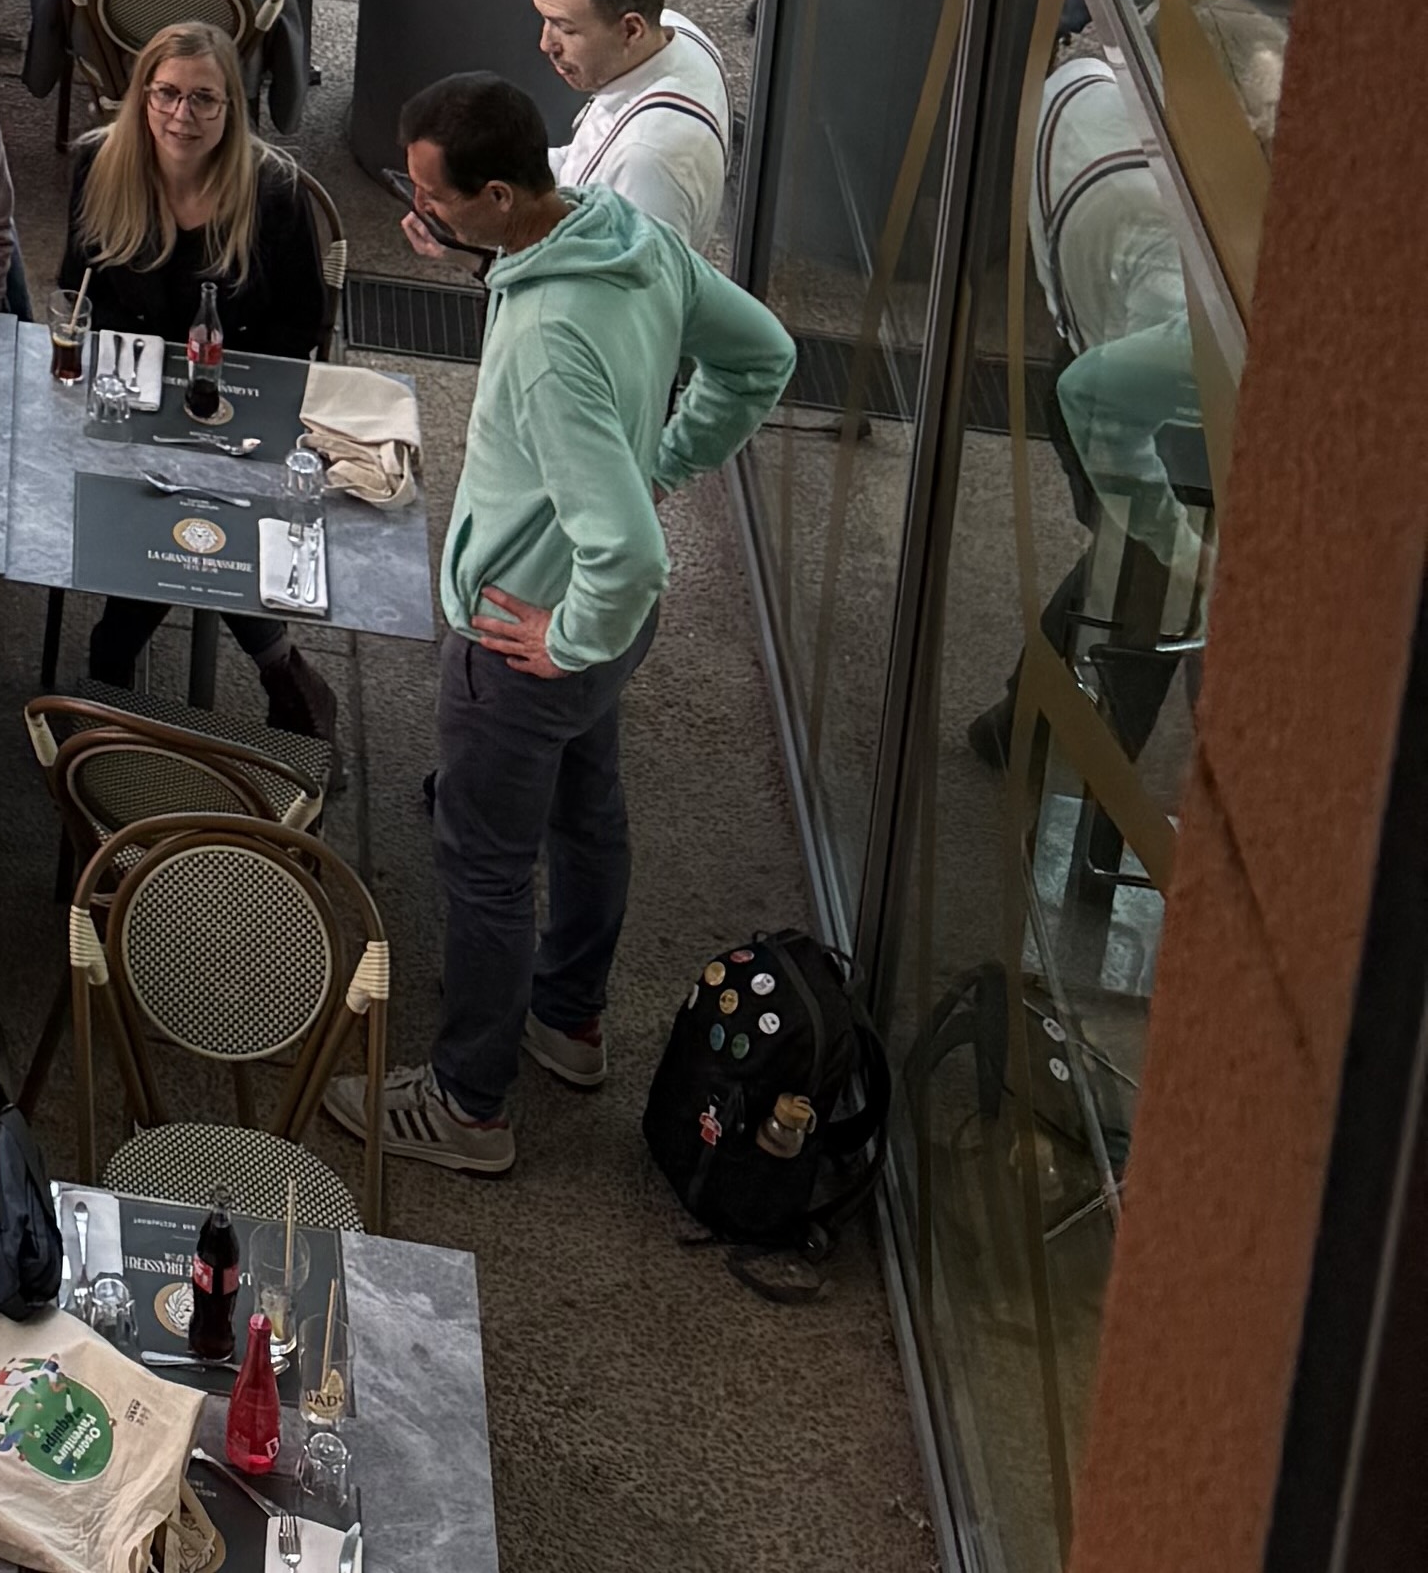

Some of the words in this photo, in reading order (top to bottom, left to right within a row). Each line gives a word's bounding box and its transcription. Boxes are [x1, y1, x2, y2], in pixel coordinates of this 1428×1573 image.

[147, 549, 160, 560] LA
[40, 1411, 75, 1455] équipe
[52, 1413, 97, 1465] l'aventure
[73, 1426, 101, 1460] Osons
